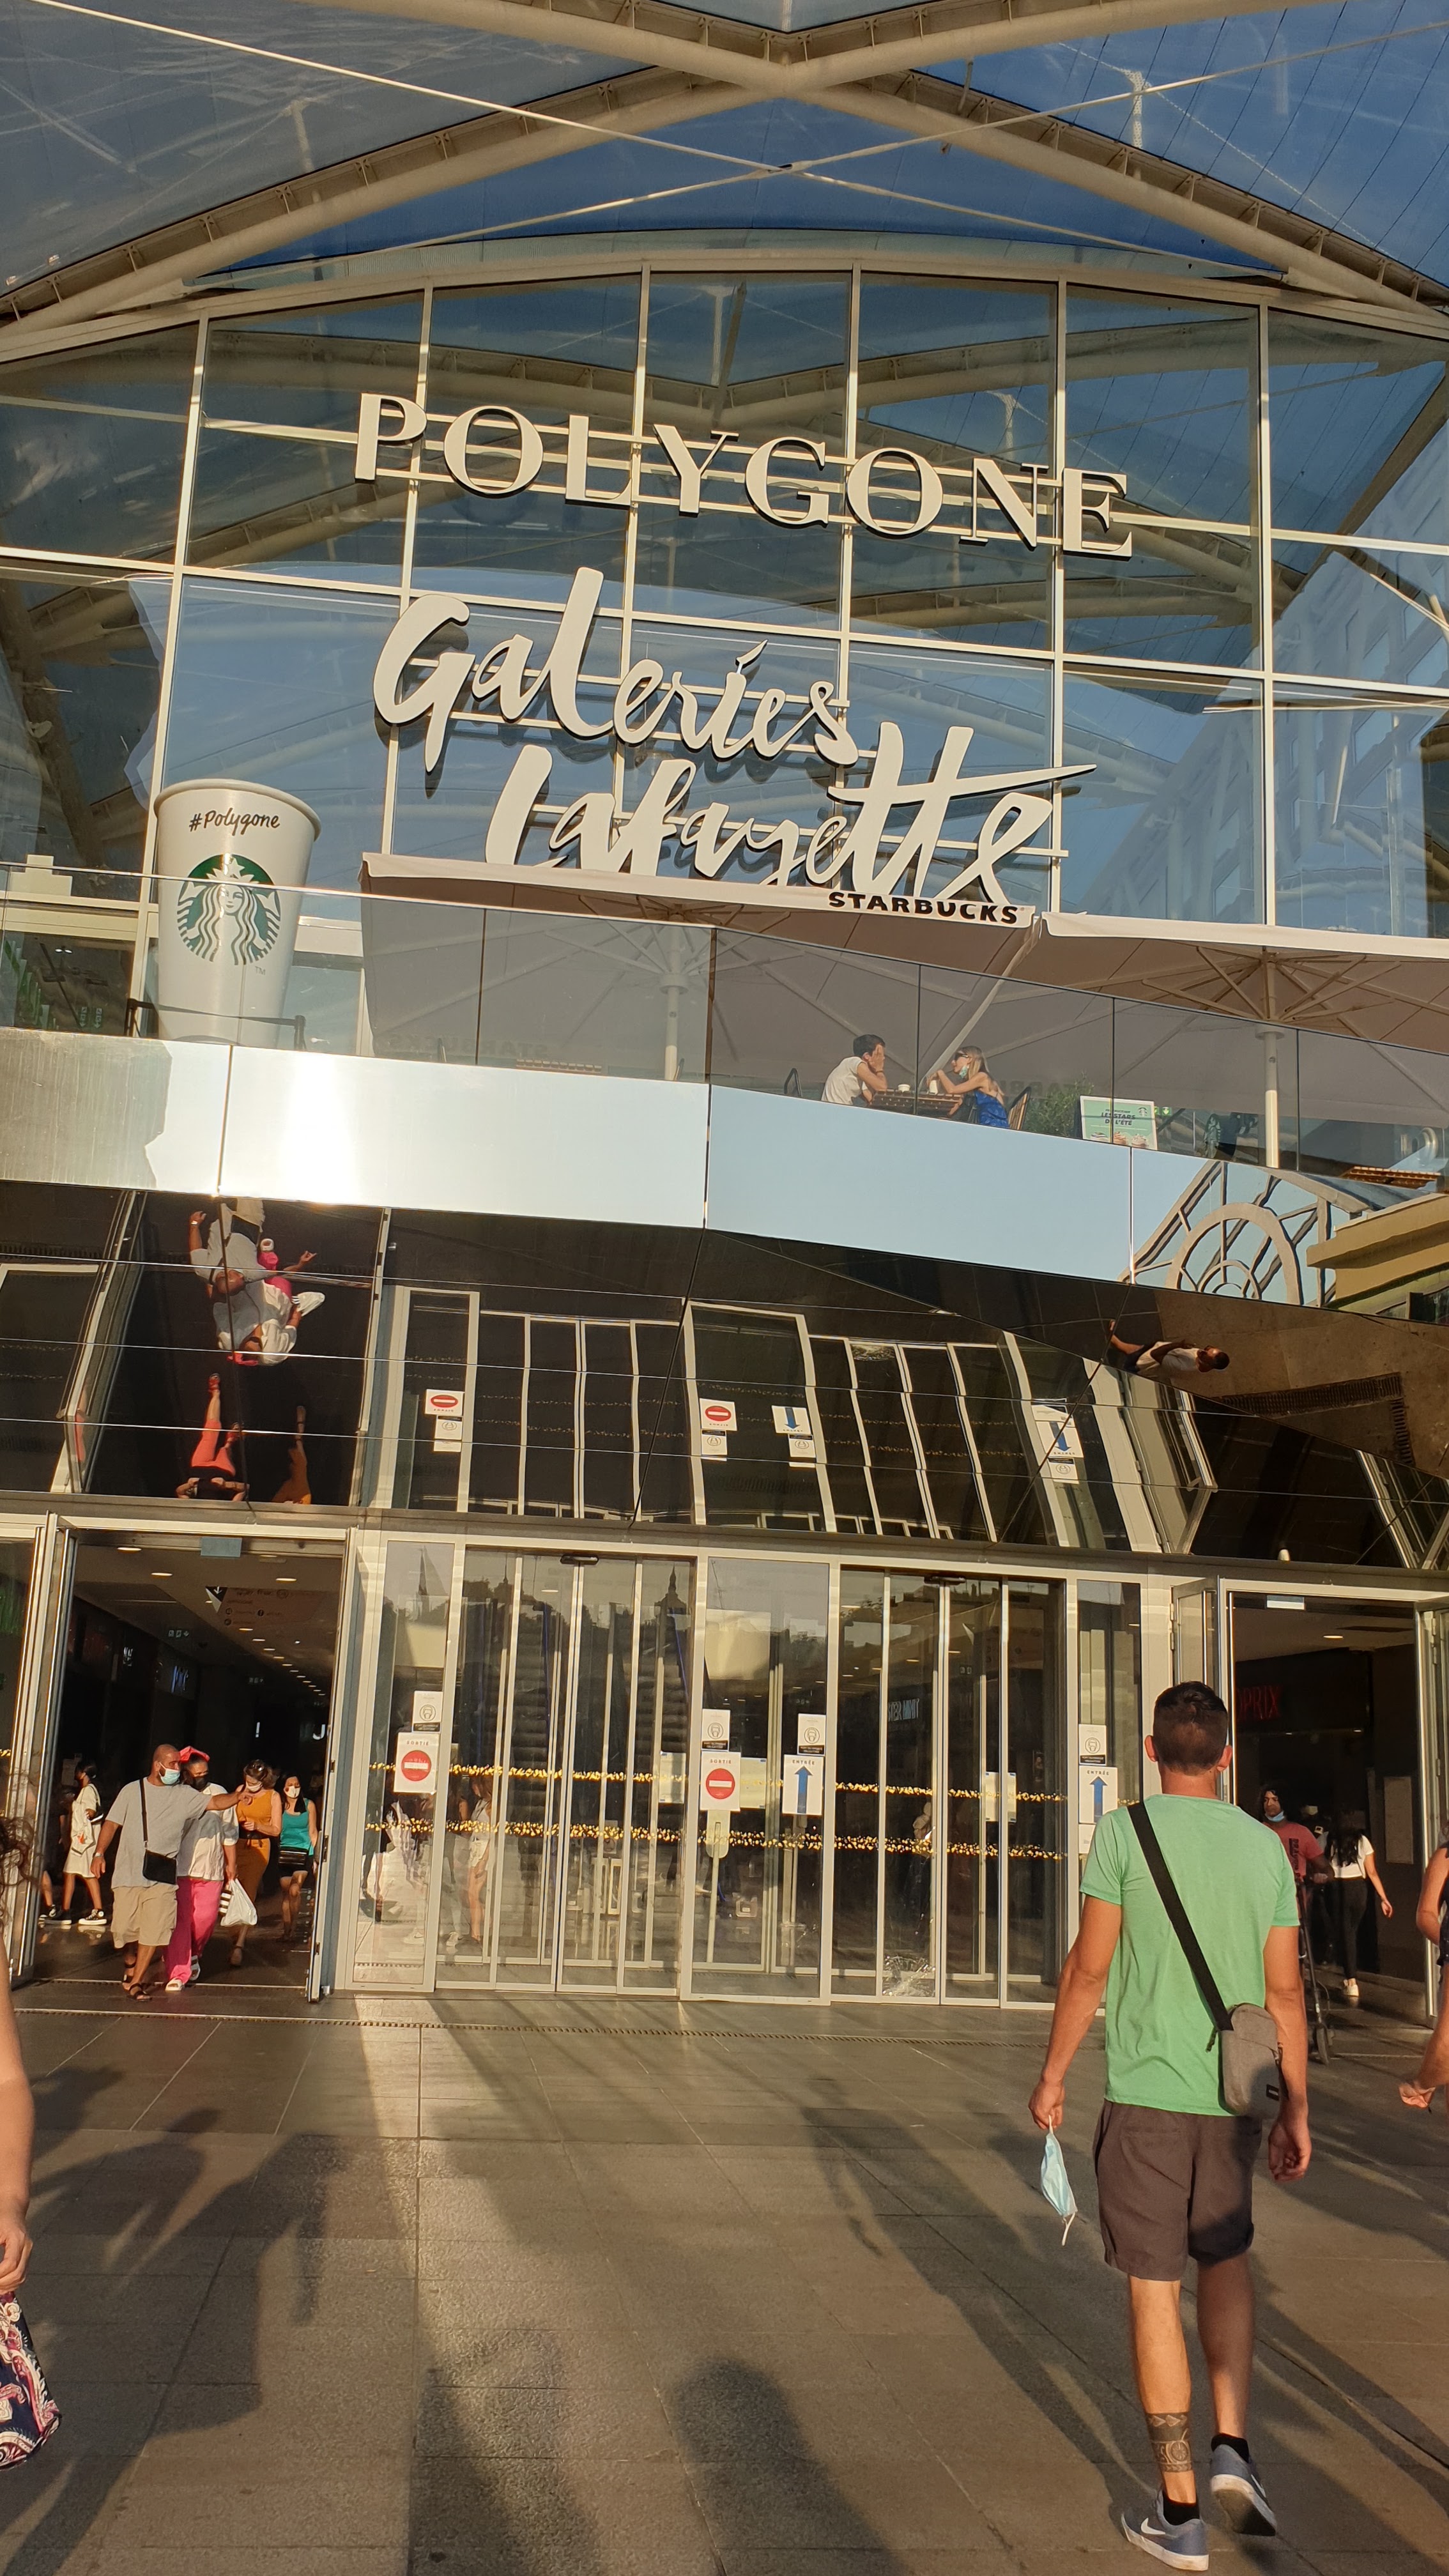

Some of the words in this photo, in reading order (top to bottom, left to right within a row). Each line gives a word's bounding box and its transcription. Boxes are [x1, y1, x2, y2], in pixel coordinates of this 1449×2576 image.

[355, 392, 1133, 558] POLYGONE
[373, 567, 859, 772] Galeries
[189, 808, 280, 836] #Polygone
[486, 721, 1096, 902] Lafayette
[829, 892, 1018, 924] STARBUCKS
